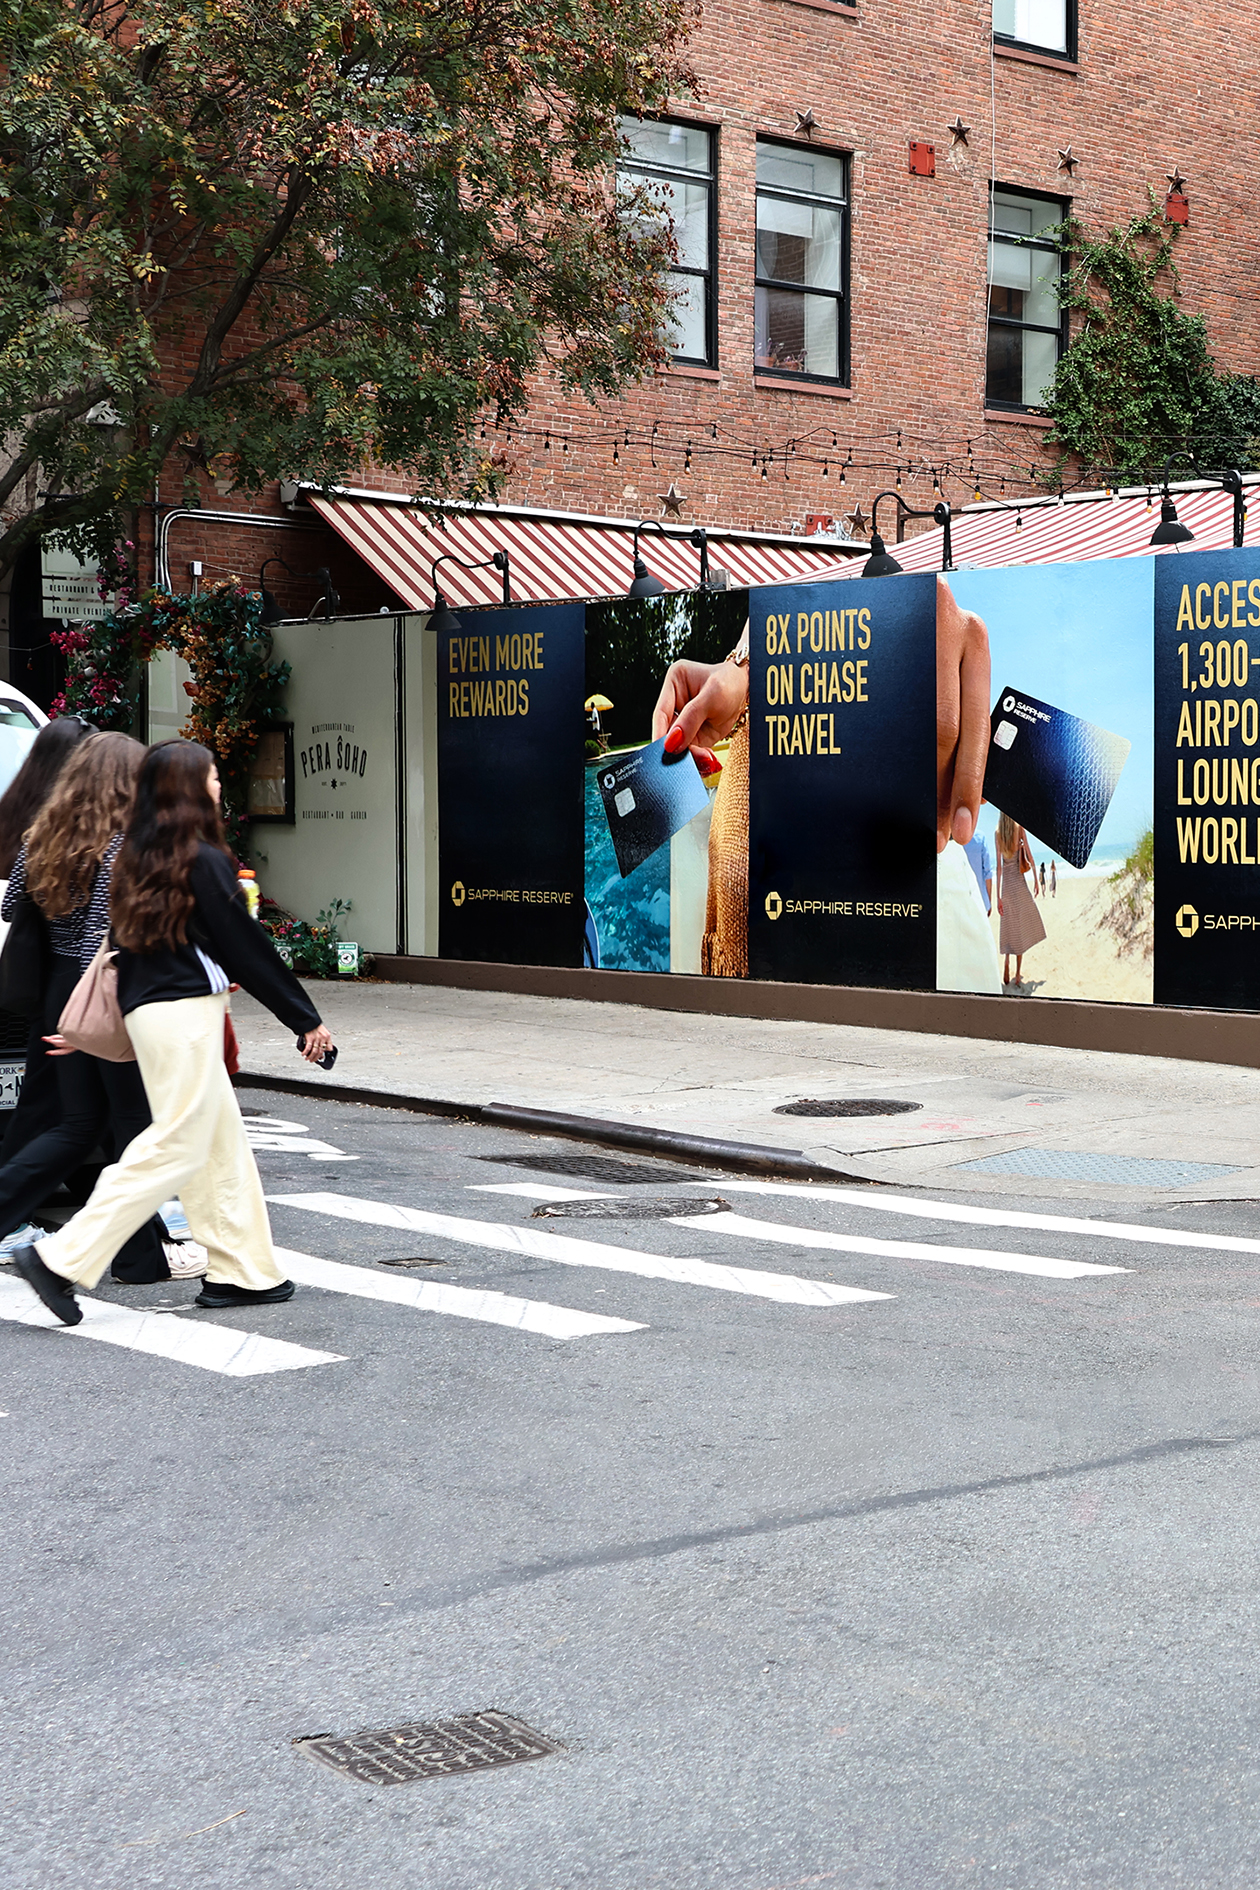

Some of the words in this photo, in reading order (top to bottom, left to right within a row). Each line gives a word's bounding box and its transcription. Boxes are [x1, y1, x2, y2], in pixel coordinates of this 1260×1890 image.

[49, 584, 88, 594] RESTAURANT
[52, 606, 80, 615] PRIVATE
[766, 614, 791, 655] 8X
[797, 607, 871, 653] POINTS
[449, 636, 490, 673] EVEN
[495, 632, 544, 671] MORE
[766, 664, 794, 706] ON
[800, 660, 869, 704] CHASE
[449, 678, 529, 718] REWARDS
[1013, 708, 1038, 724] RESERVE
[1016, 701, 1053, 723] SAPPHIRE
[765, 713, 841, 756] TRAVEL
[300, 742, 332, 778] PERA
[467, 888, 520, 902] SAPPHIRE
[522, 891, 572, 904] RESERVE
[785, 900, 853, 915] SAPPHIRE
[856, 902, 920, 918] RESERVE
[0, 1067, 18, 1075] ORK
